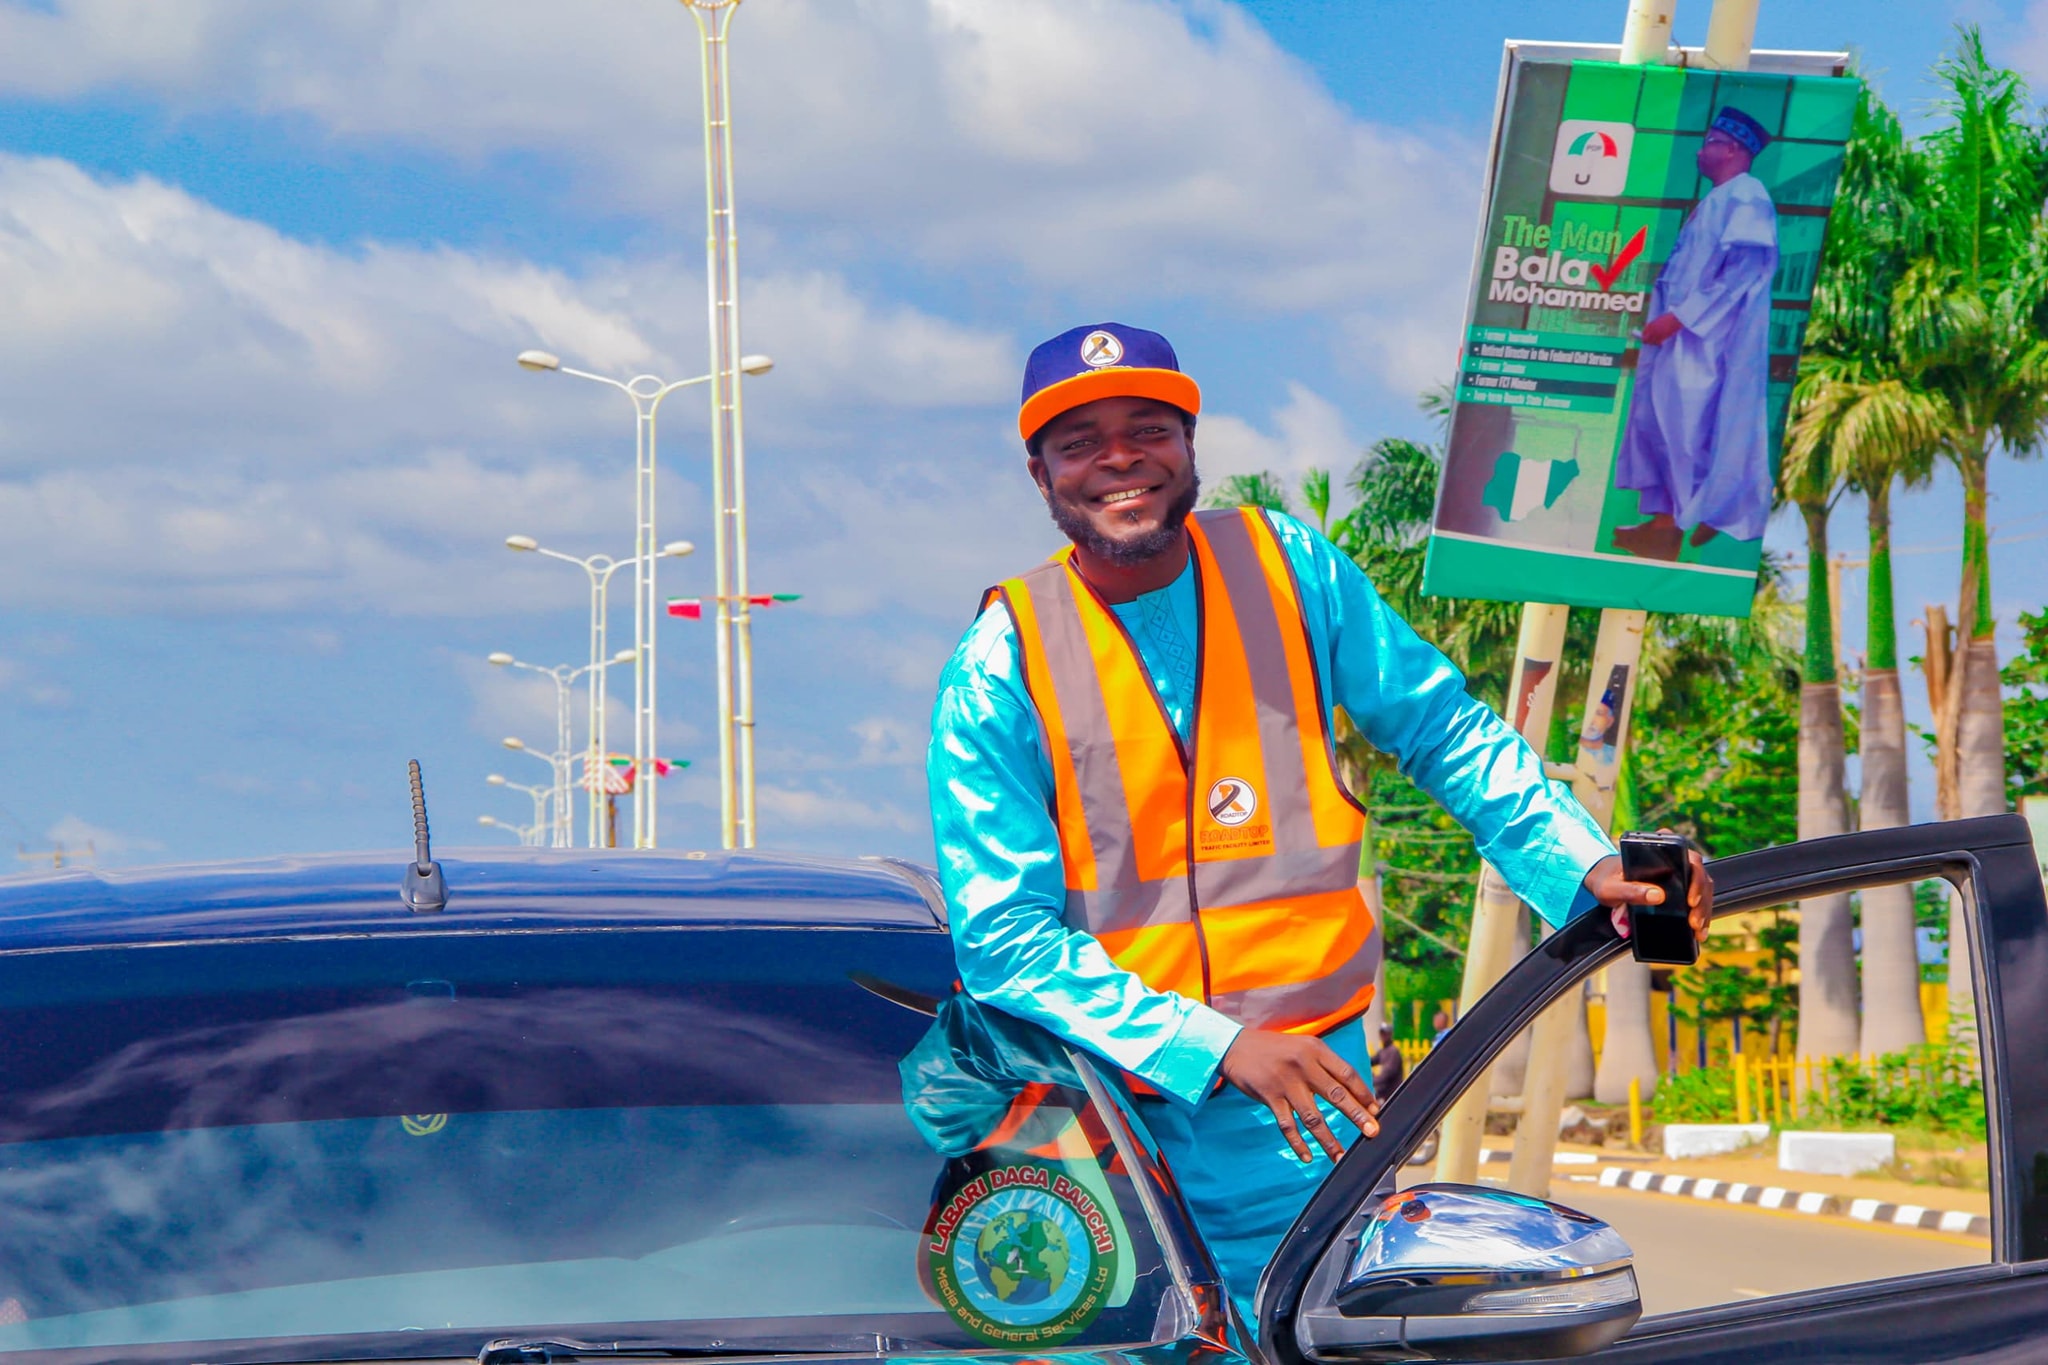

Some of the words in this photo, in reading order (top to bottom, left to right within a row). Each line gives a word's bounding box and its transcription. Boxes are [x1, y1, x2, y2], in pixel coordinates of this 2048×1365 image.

[1503, 215, 1550, 249] The
[1561, 220, 1622, 255] Man
[1493, 246, 1590, 286] Bala
[1488, 279, 1645, 312] Mohammed
